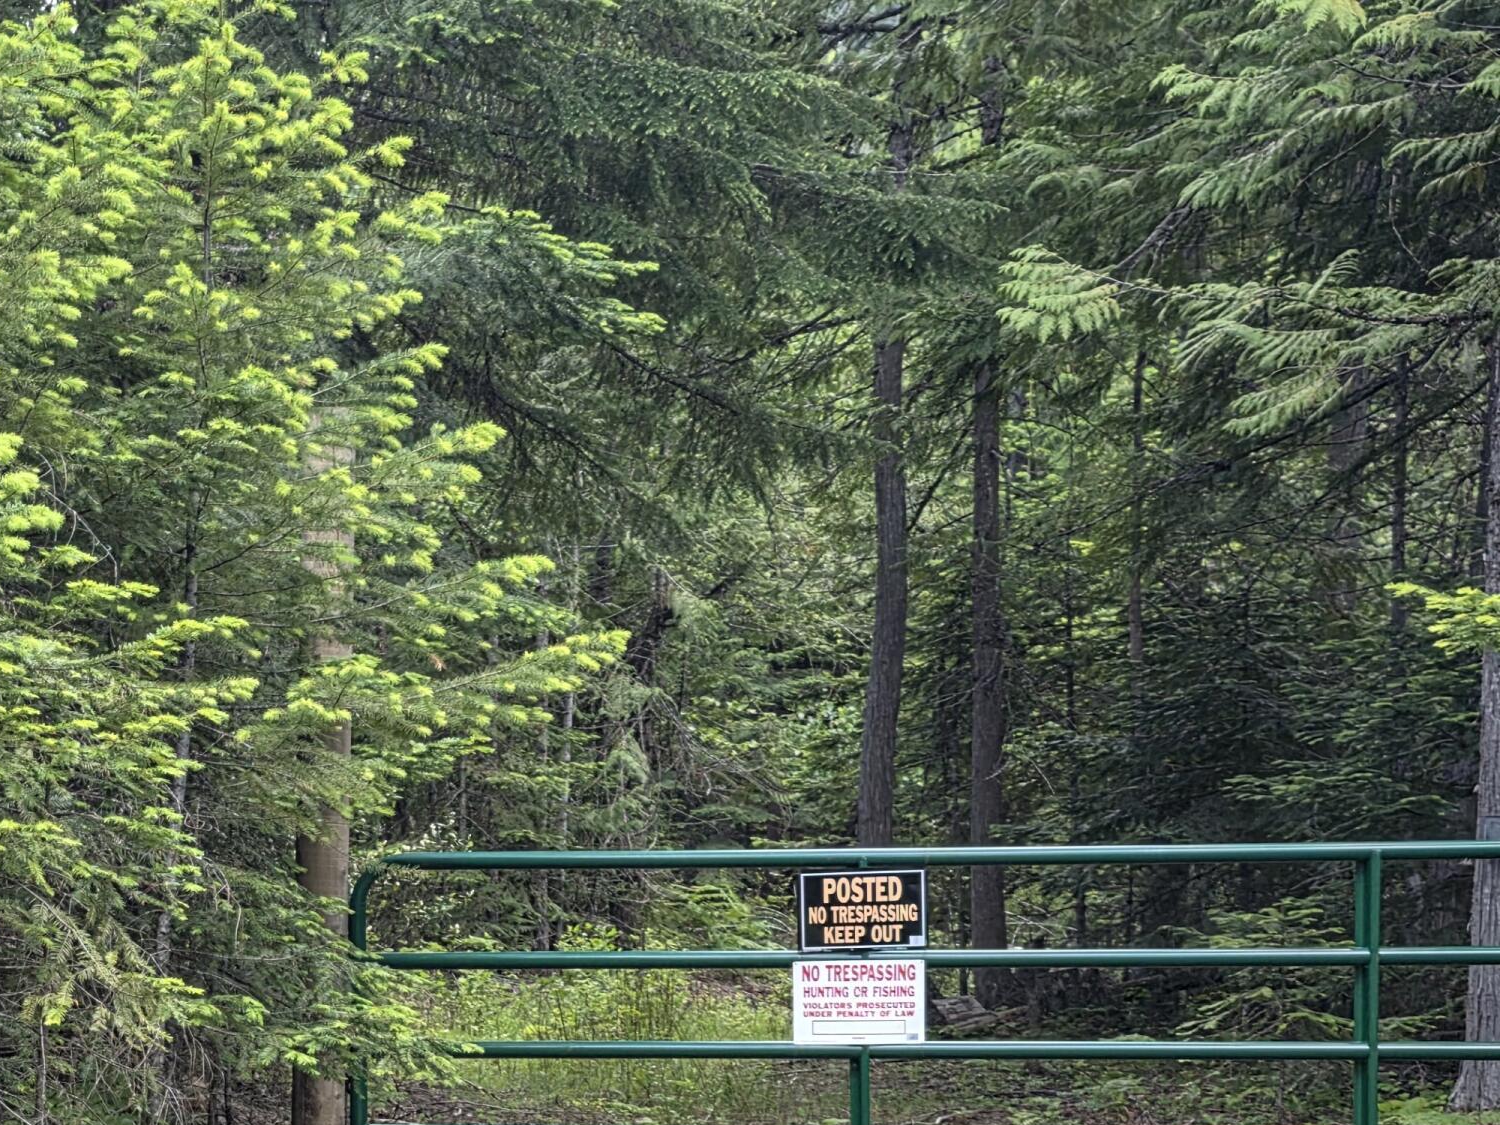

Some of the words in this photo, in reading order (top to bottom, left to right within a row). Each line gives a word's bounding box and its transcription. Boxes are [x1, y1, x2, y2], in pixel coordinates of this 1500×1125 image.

[822, 876, 902, 903] POSTED
[808, 906, 827, 924] NO
[831, 903, 918, 923] TRESPASSING
[823, 926, 865, 944] KEEP
[871, 924, 903, 942] OUT
[802, 965, 820, 981] NO
[825, 964, 916, 981] TRESPASSING
[803, 987, 849, 998] HUNTING
[853, 987, 868, 998] OR
[873, 986, 915, 997] FISHING
